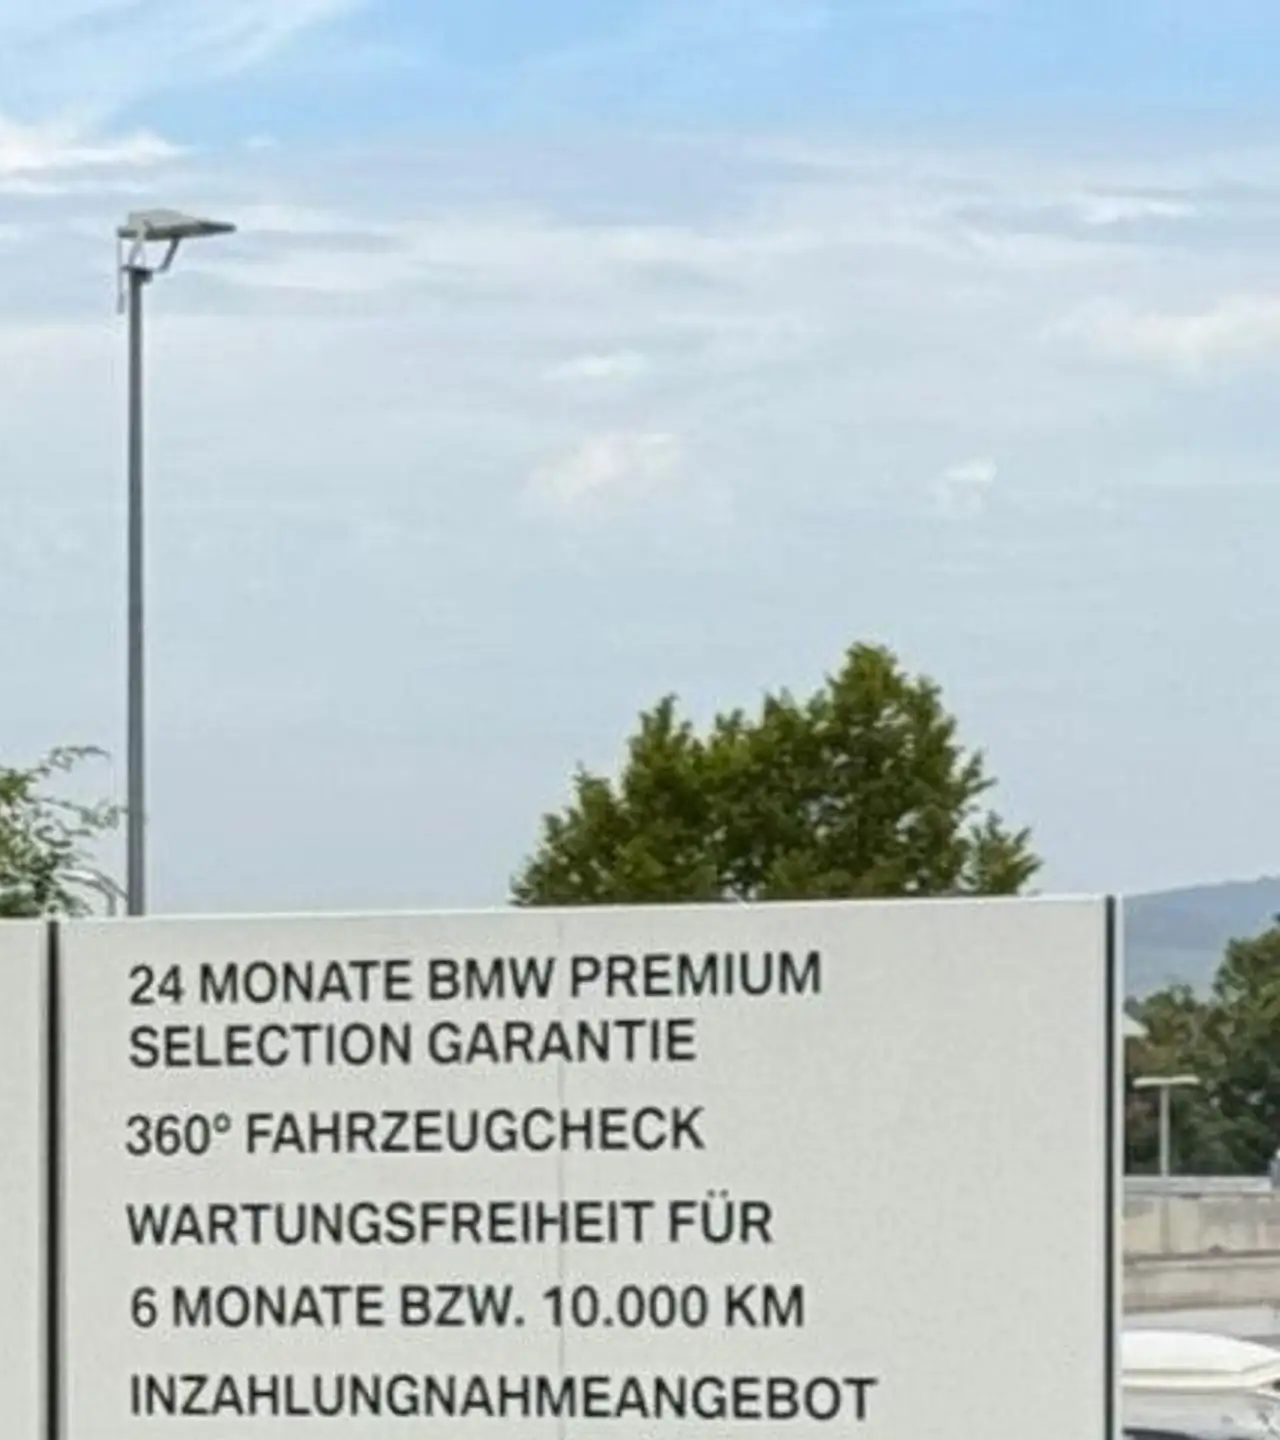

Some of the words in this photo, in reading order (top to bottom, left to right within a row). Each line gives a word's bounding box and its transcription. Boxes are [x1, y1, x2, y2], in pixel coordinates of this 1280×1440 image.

[131, 965, 183, 1005] 24
[201, 960, 411, 1003] MONATE
[429, 957, 554, 1000] BMW
[572, 951, 820, 997] PREMIUM
[131, 1023, 410, 1067] SELECTION
[429, 1019, 695, 1064] GARANTIE
[127, 1114, 230, 1155] 360°
[248, 1107, 703, 1153] FAHRZEUGCHECK
[127, 1201, 653, 1244] WARTUNGSFREIHEIT
[670, 1192, 771, 1243] FÜR
[132, 1287, 156, 1327] 6
[174, 1286, 383, 1327] MONATE
[401, 1285, 524, 1326] BZW.
[545, 1286, 707, 1327] 10.000
[727, 1285, 803, 1326] KM
[132, 1375, 876, 1420] INZAHLUNGNAHMEANGEBOT
